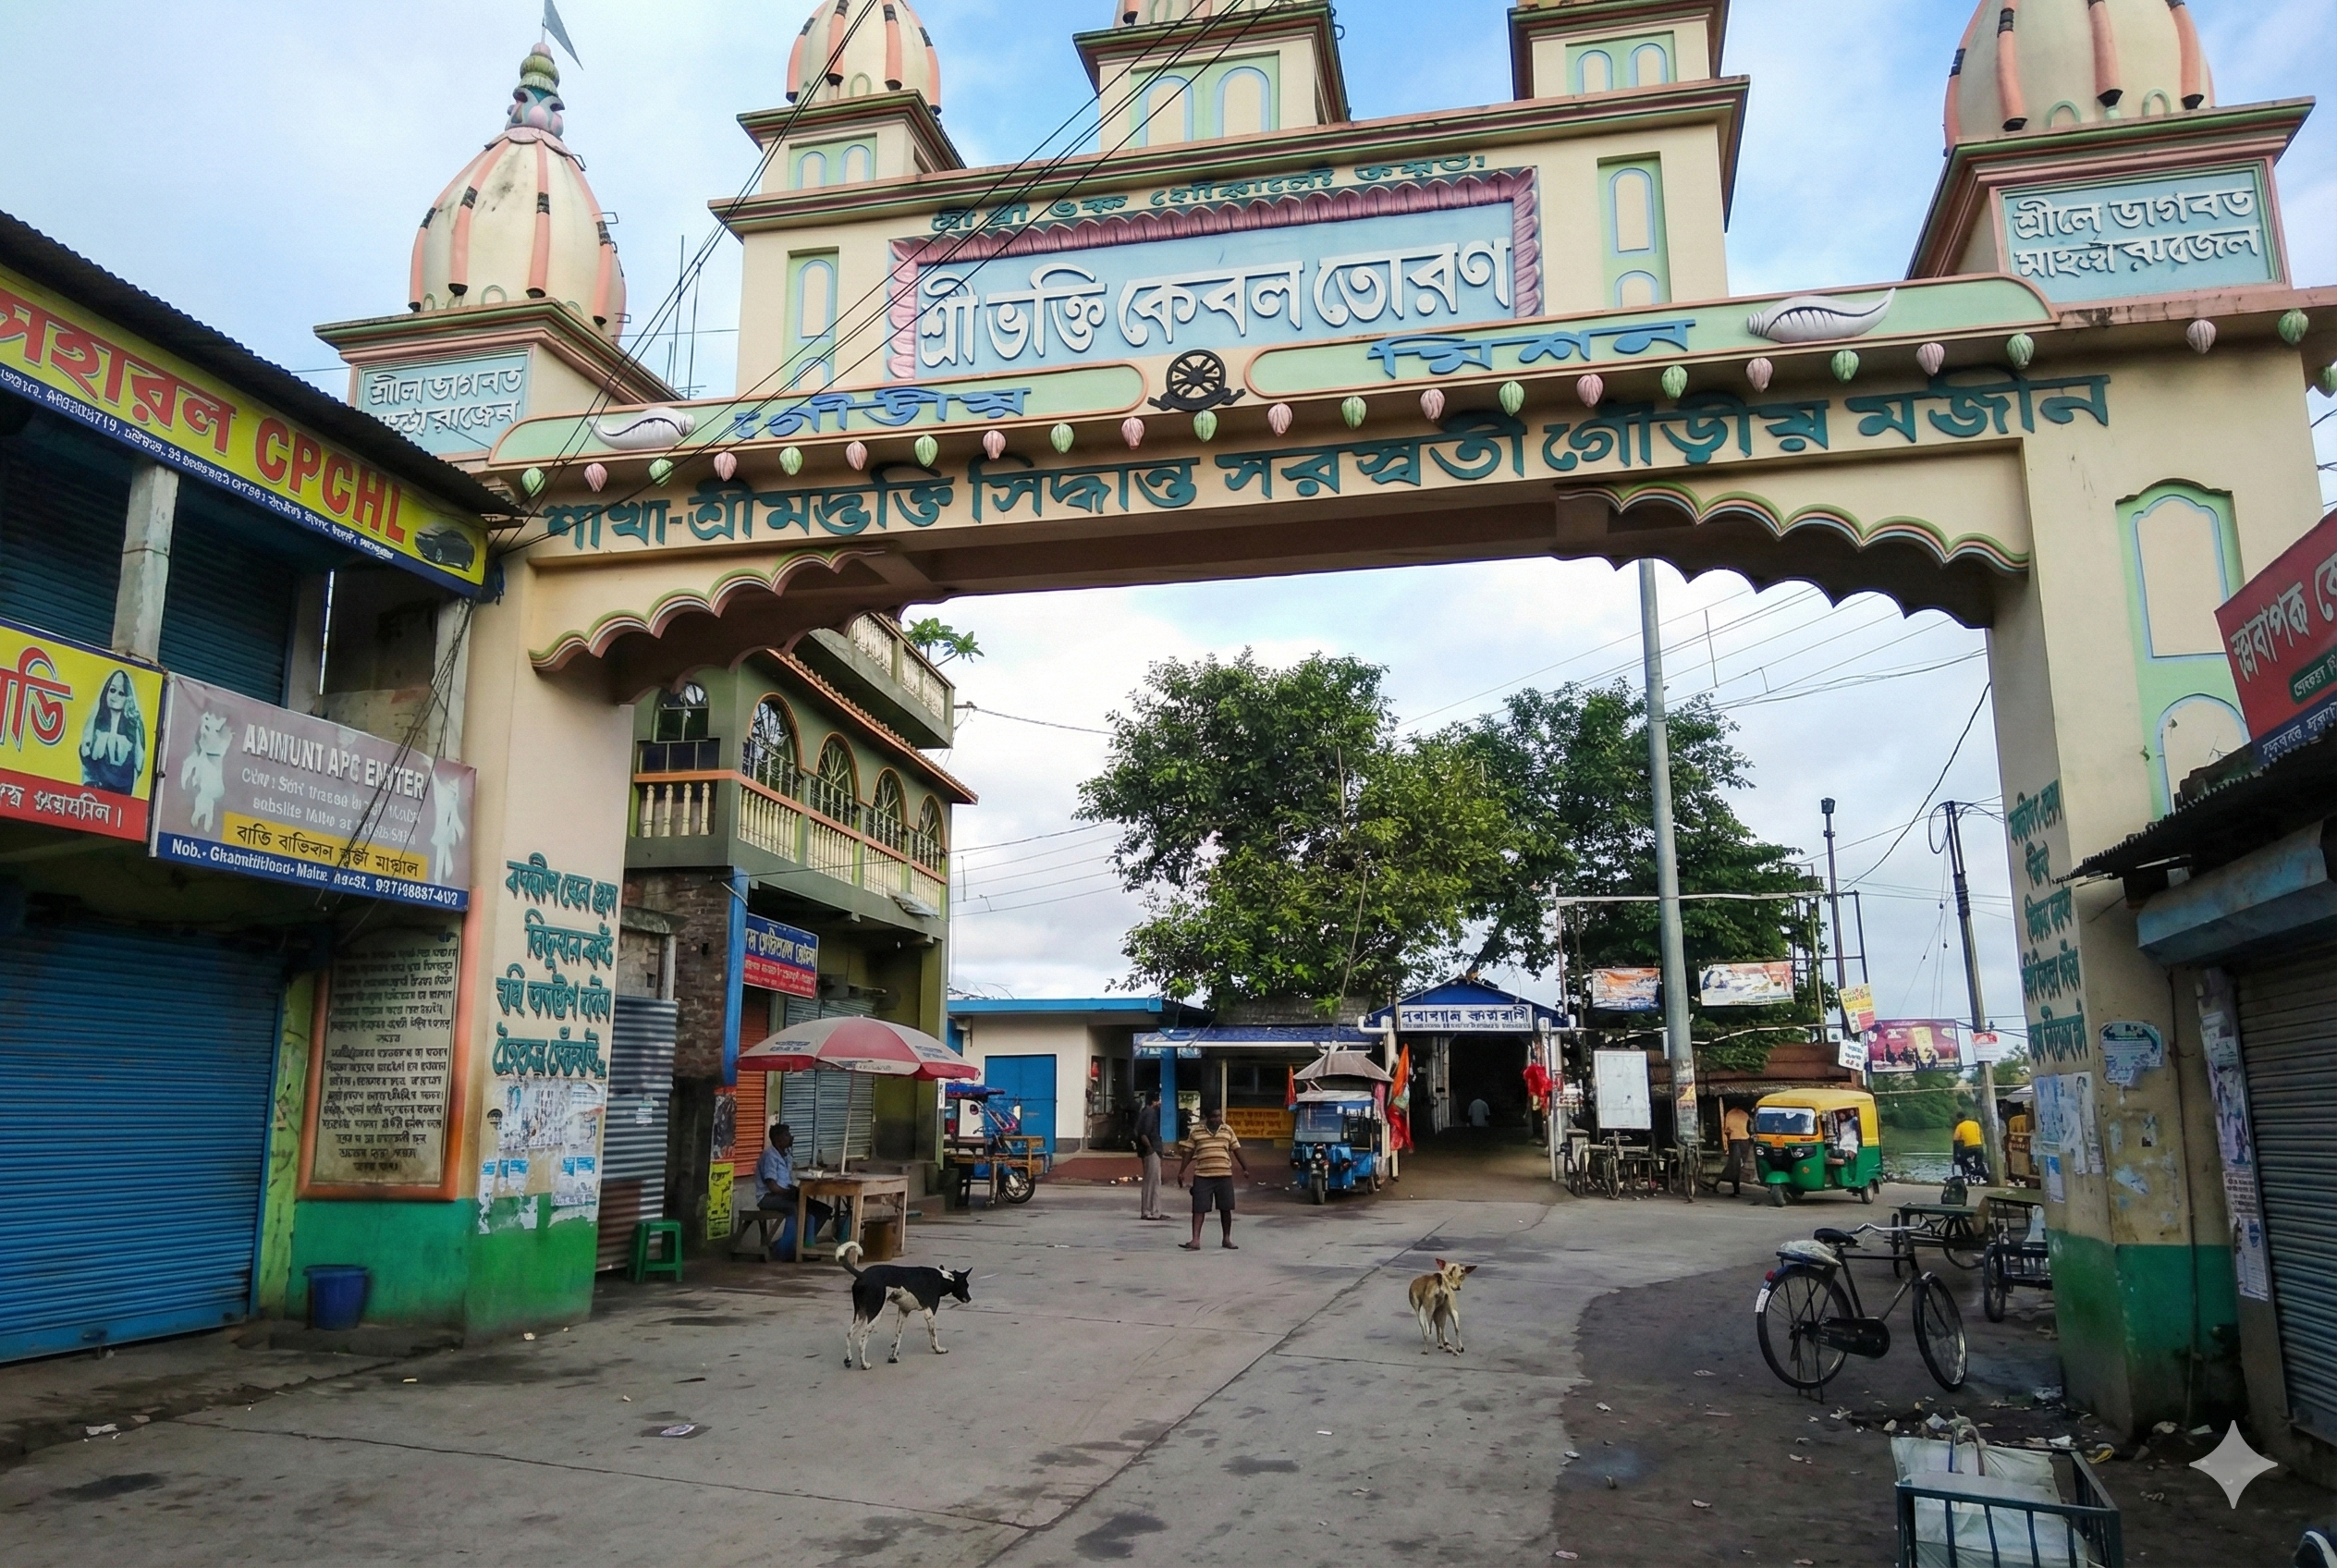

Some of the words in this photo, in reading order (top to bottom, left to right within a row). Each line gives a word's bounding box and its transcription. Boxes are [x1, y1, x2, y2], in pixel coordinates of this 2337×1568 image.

[920, 276, 978, 368] শ্রী
[985, 262, 1108, 361] ভক্তি
[1118, 261, 1305, 347] কেবল
[1314, 236, 1512, 327] তোরণ
[255, 415, 406, 546] CPCHL
[1215, 407, 1528, 499] সরস্বতী
